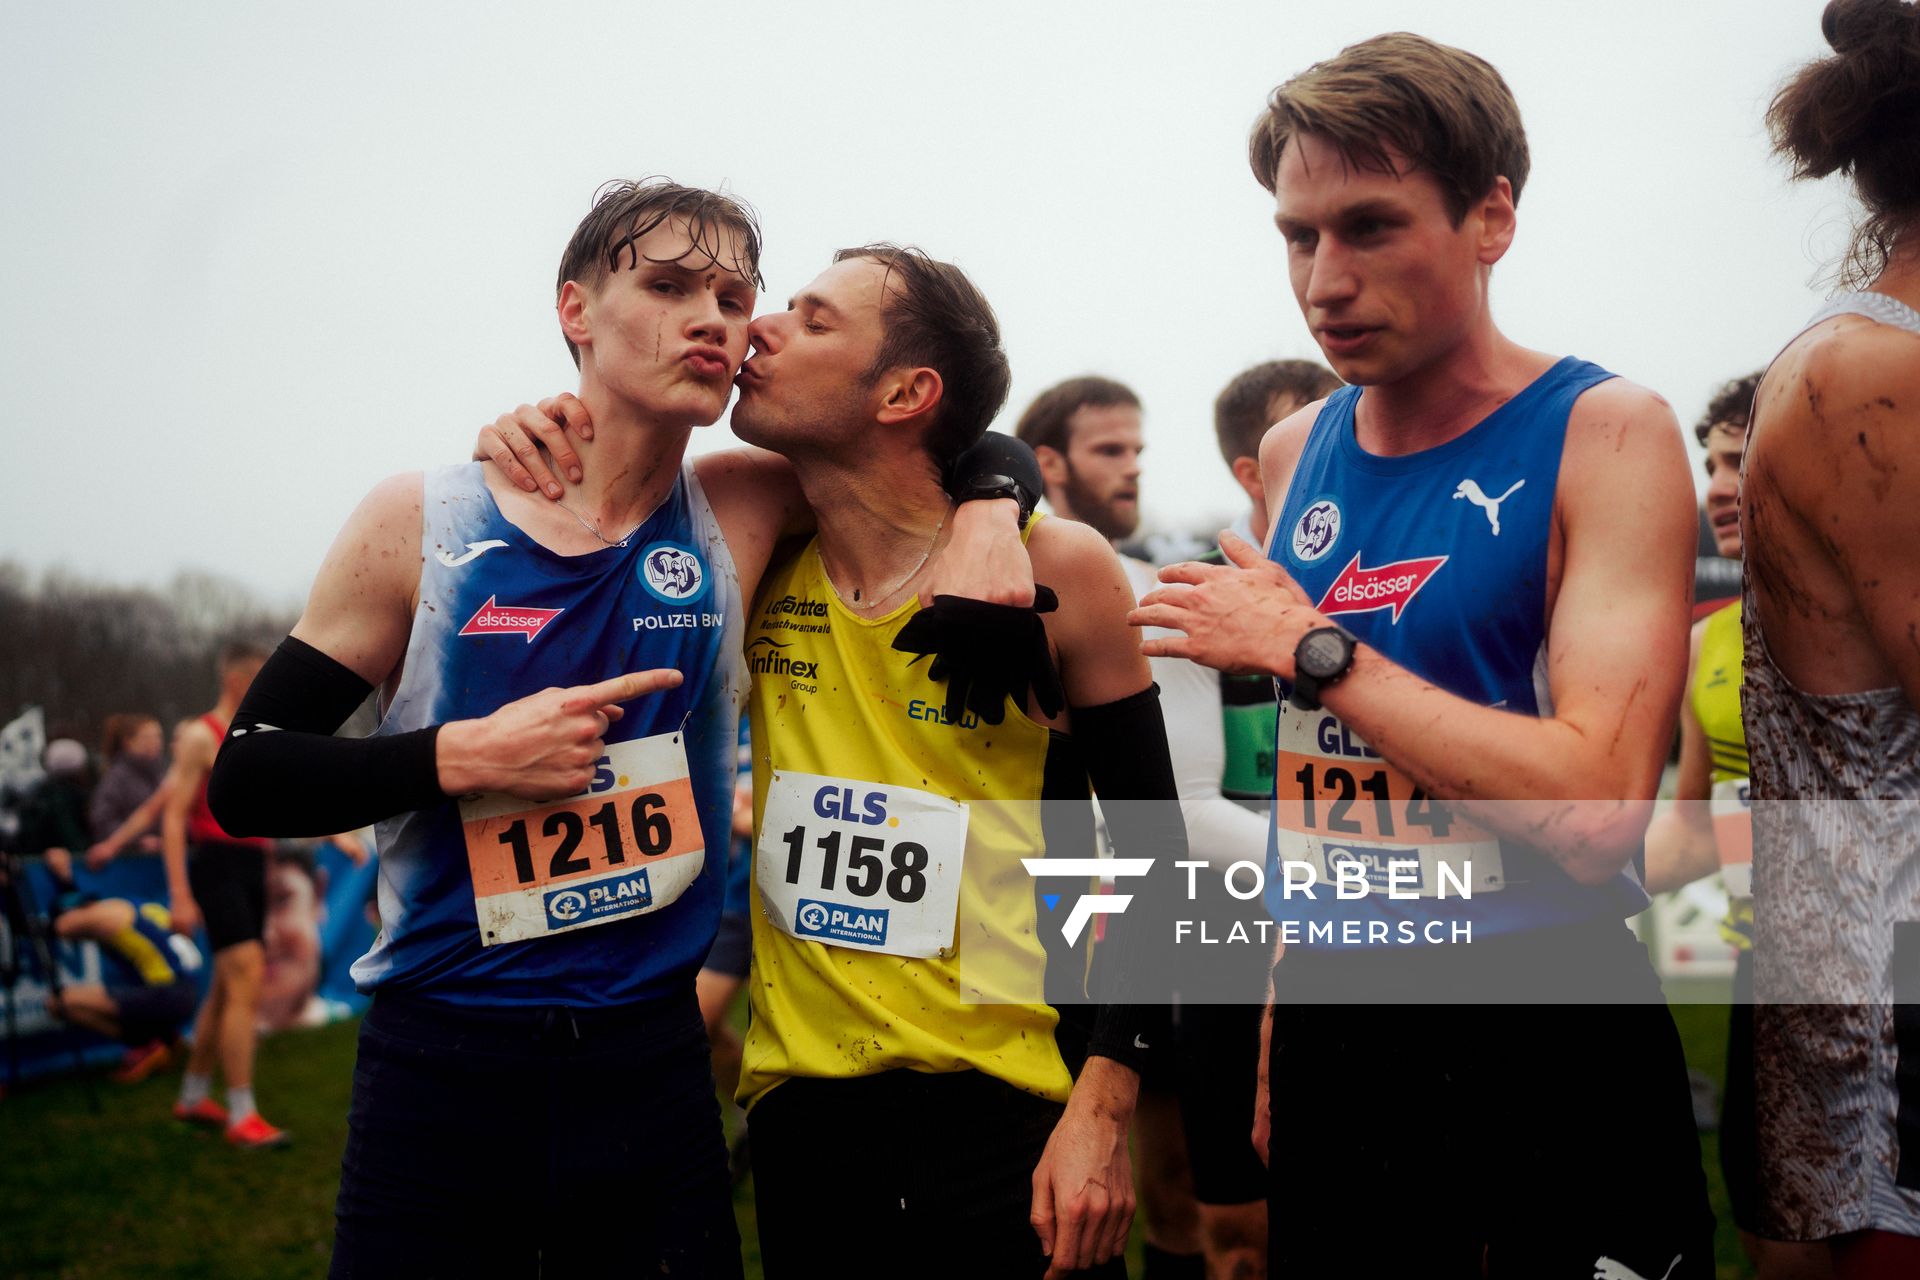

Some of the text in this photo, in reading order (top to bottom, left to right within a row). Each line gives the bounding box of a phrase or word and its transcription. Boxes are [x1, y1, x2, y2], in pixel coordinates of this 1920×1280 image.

[1333, 573, 1418, 602] elsässer
[477, 611, 544, 627] elsässer
[633, 614, 698, 631] POLIZEI
[751, 649, 819, 680] infinex
[790, 680, 818, 695] Group
[1317, 716, 1382, 758] GL
[1296, 763, 1453, 838] 1214
[498, 793, 673, 884] 1216
[783, 825, 929, 904] 1158
[588, 877, 647, 906] PLAN
[829, 927, 882, 942] INTERNATIONAL
[830, 910, 884, 933] PLAN
